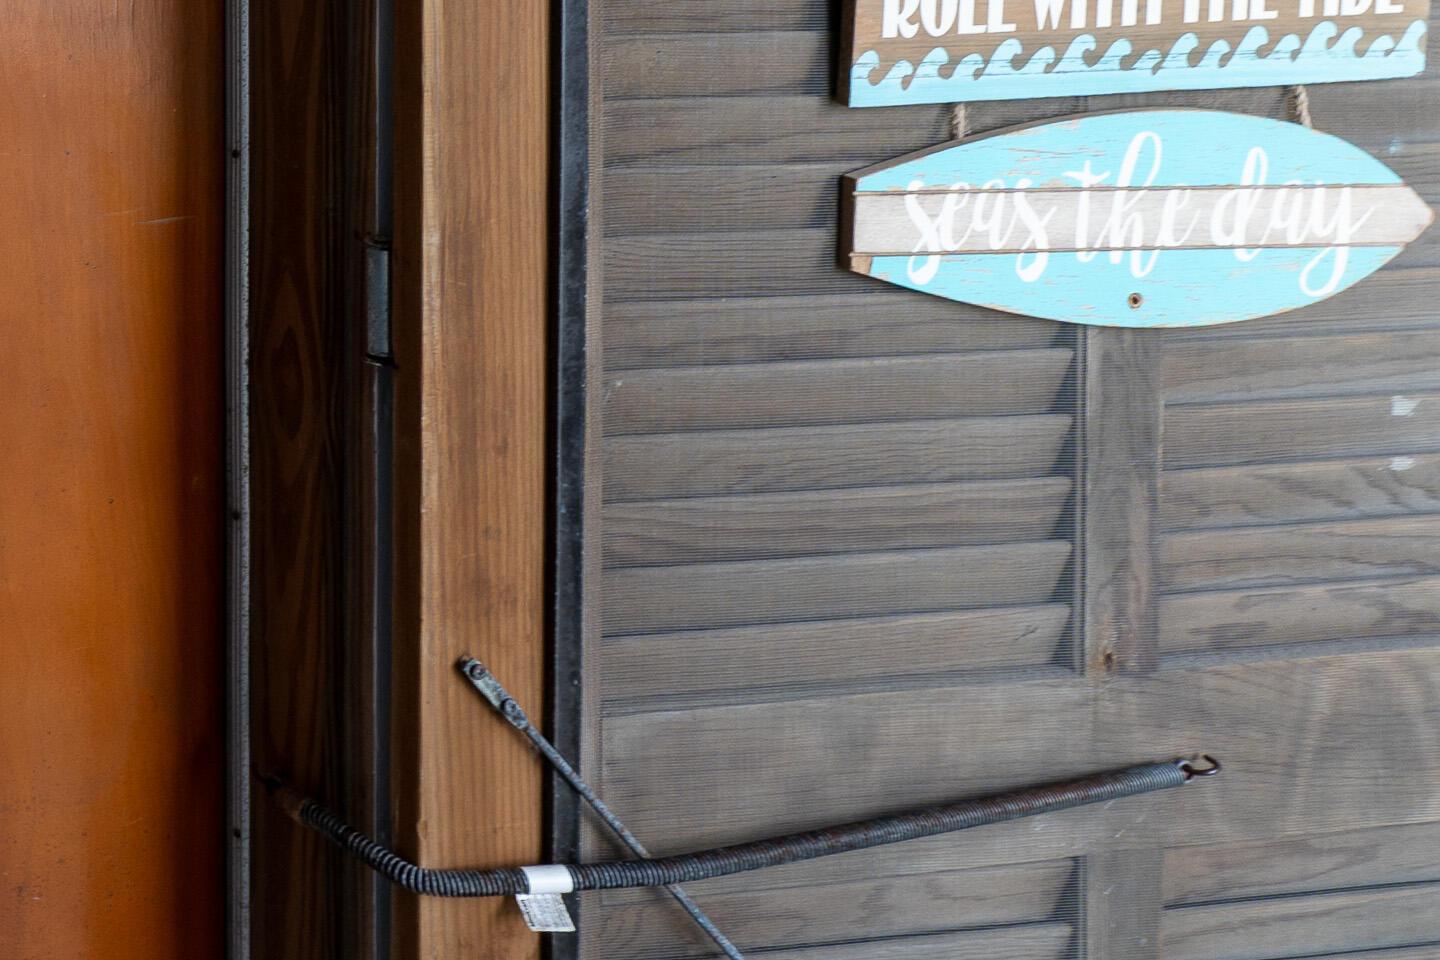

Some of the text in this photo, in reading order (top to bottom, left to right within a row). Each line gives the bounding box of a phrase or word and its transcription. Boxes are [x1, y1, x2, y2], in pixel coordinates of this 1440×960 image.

[903, 131, 1374, 297] seas the day
